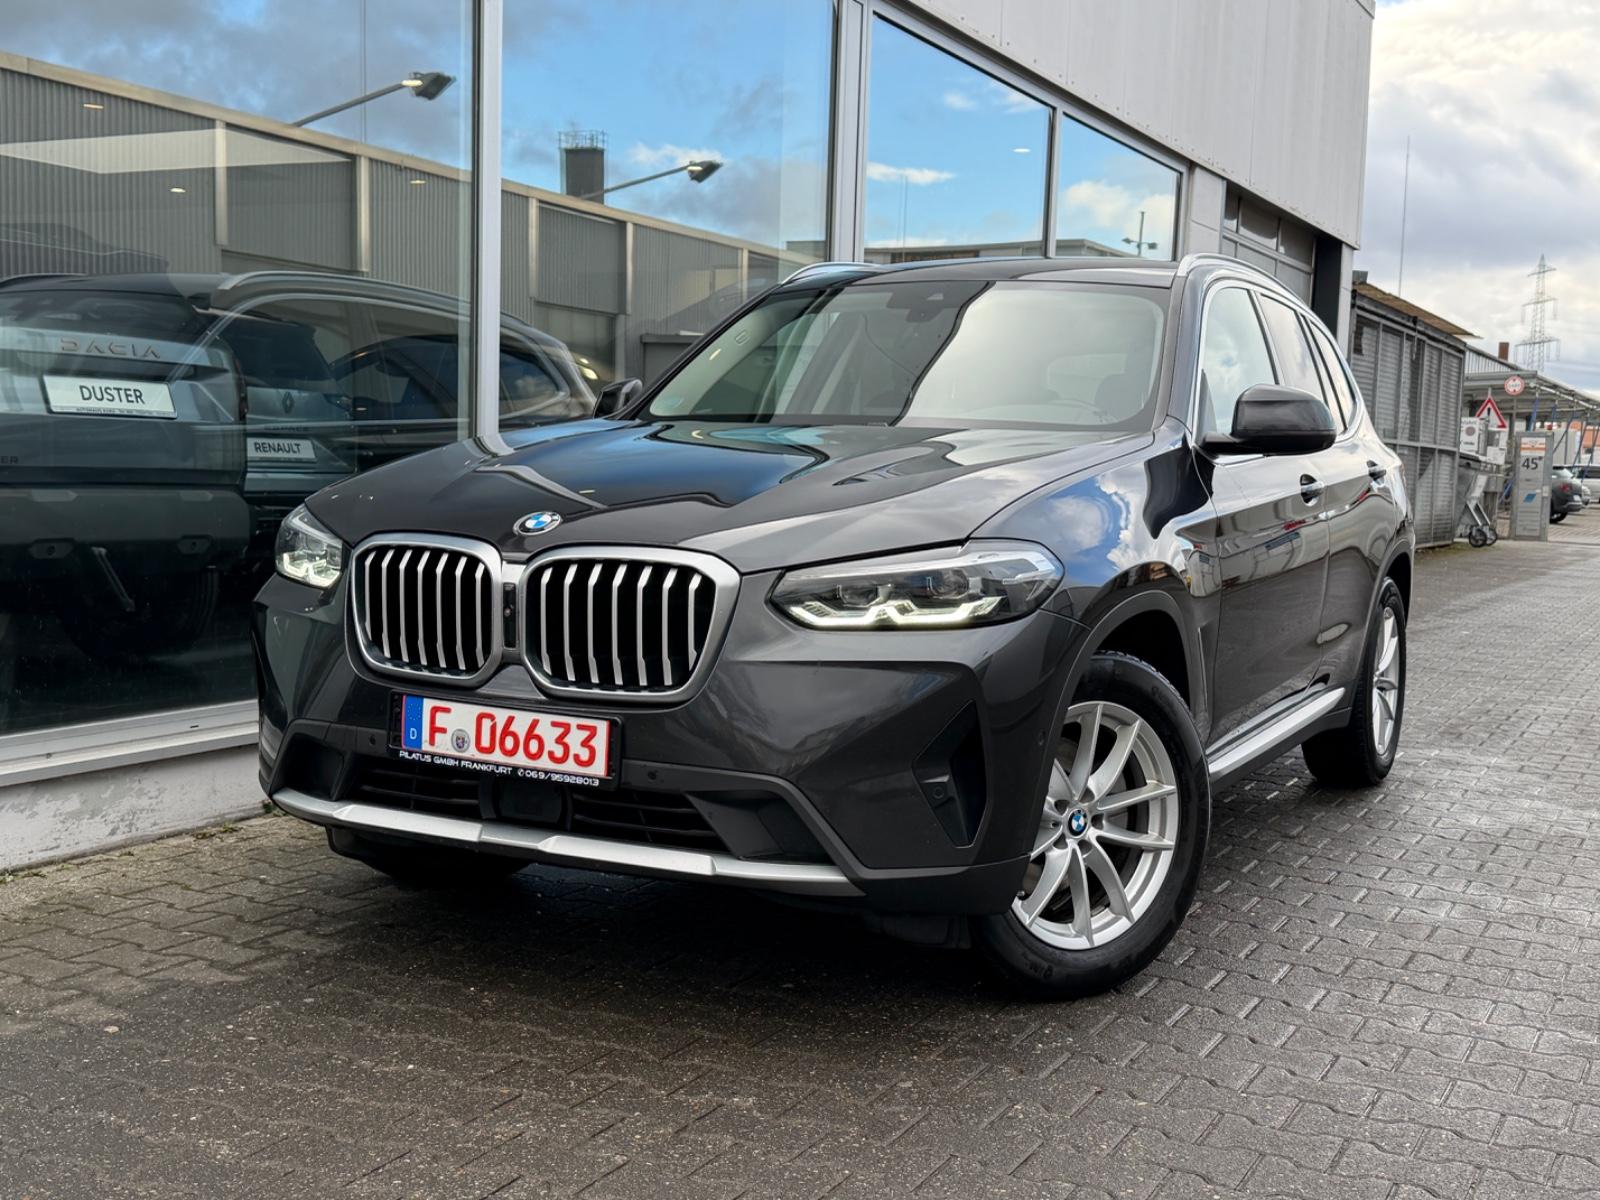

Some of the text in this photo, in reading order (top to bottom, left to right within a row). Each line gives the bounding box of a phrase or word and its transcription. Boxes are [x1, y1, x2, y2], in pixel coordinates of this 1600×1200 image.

[61, 338, 160, 359] DACIA
[79, 385, 145, 404] DUSTER
[254, 441, 302, 454] RENAULT
[409, 727, 418, 740] D
[428, 705, 598, 768] F 06633
[399, 750, 432, 763] PILATUS
[433, 756, 459, 767] GMBH
[461, 760, 513, 775] FRANKFURT
